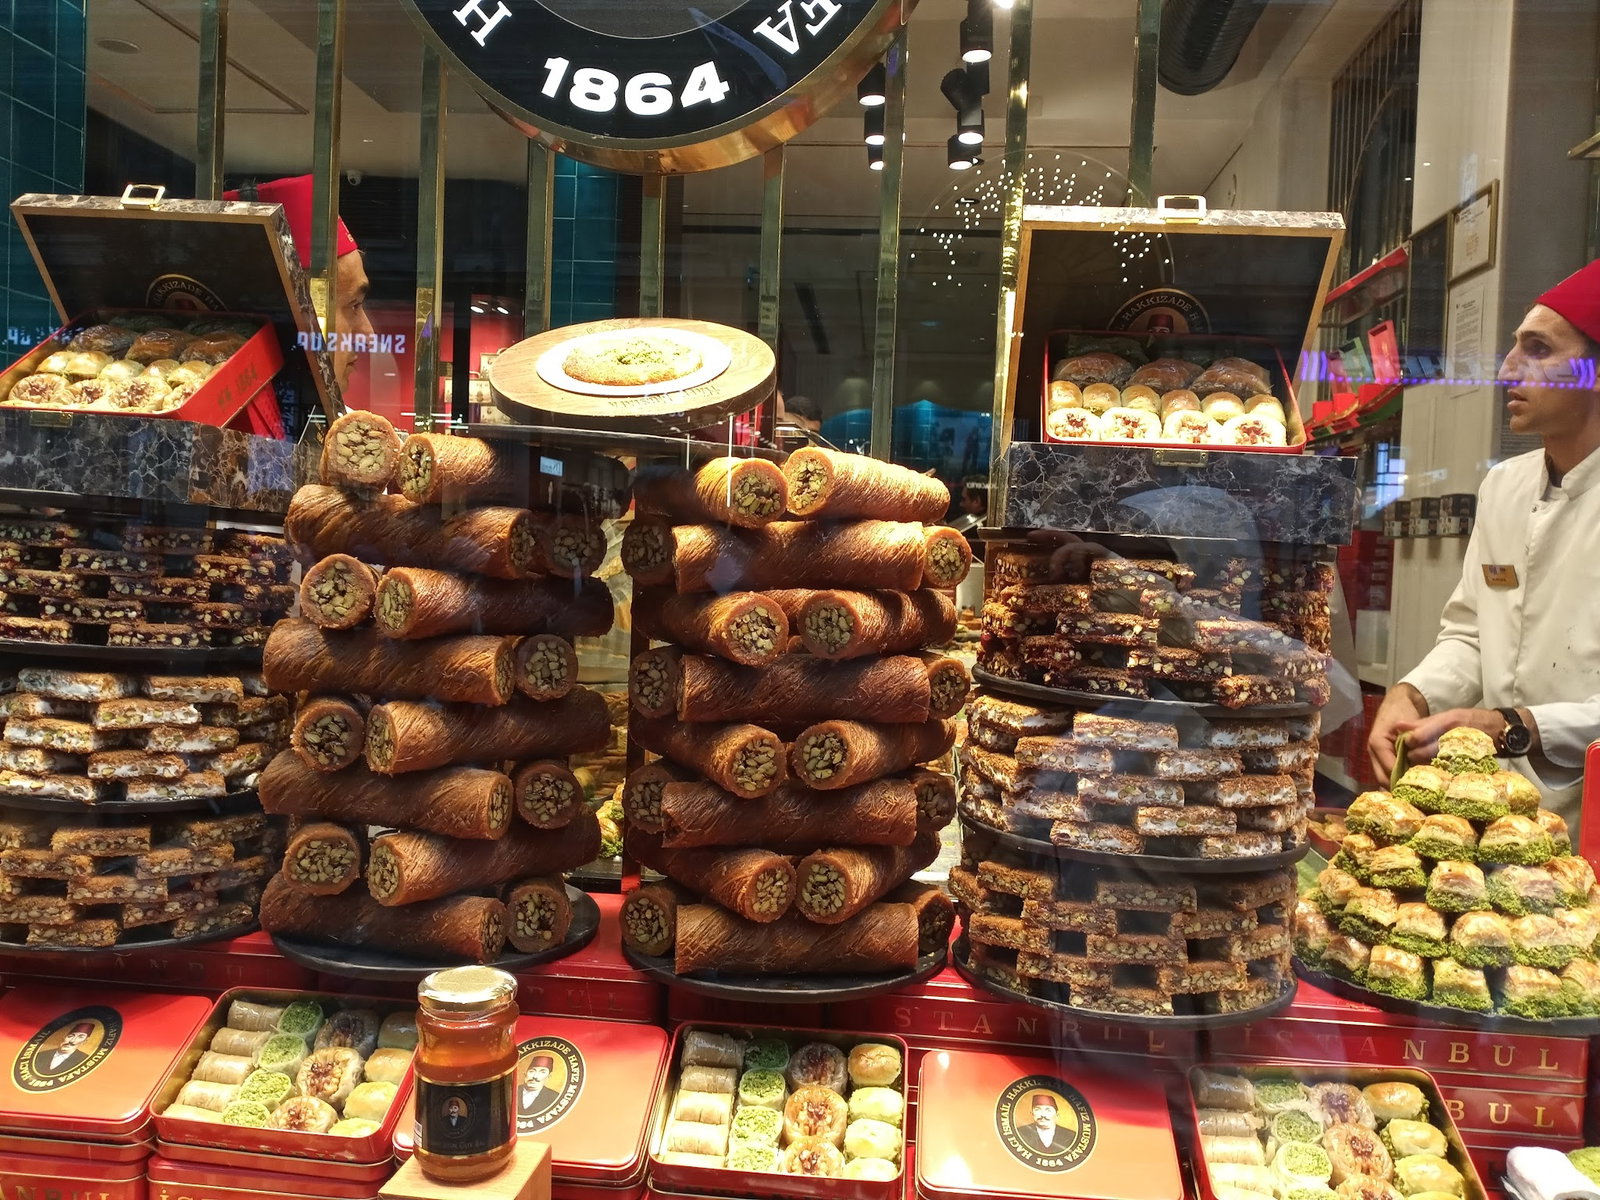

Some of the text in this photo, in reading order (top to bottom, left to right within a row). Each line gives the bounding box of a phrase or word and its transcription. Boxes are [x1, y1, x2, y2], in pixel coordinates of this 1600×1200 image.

[542, 57, 729, 116] 1864
[1122, 295, 1192, 321] HAKKIZADE
[567, 1054, 580, 1083] HAFIZ
[536, 1084, 578, 1124] MUSTAFA
[1008, 1136, 1033, 1160] HACI
[1064, 1123, 1091, 1162] MUSTAFA
